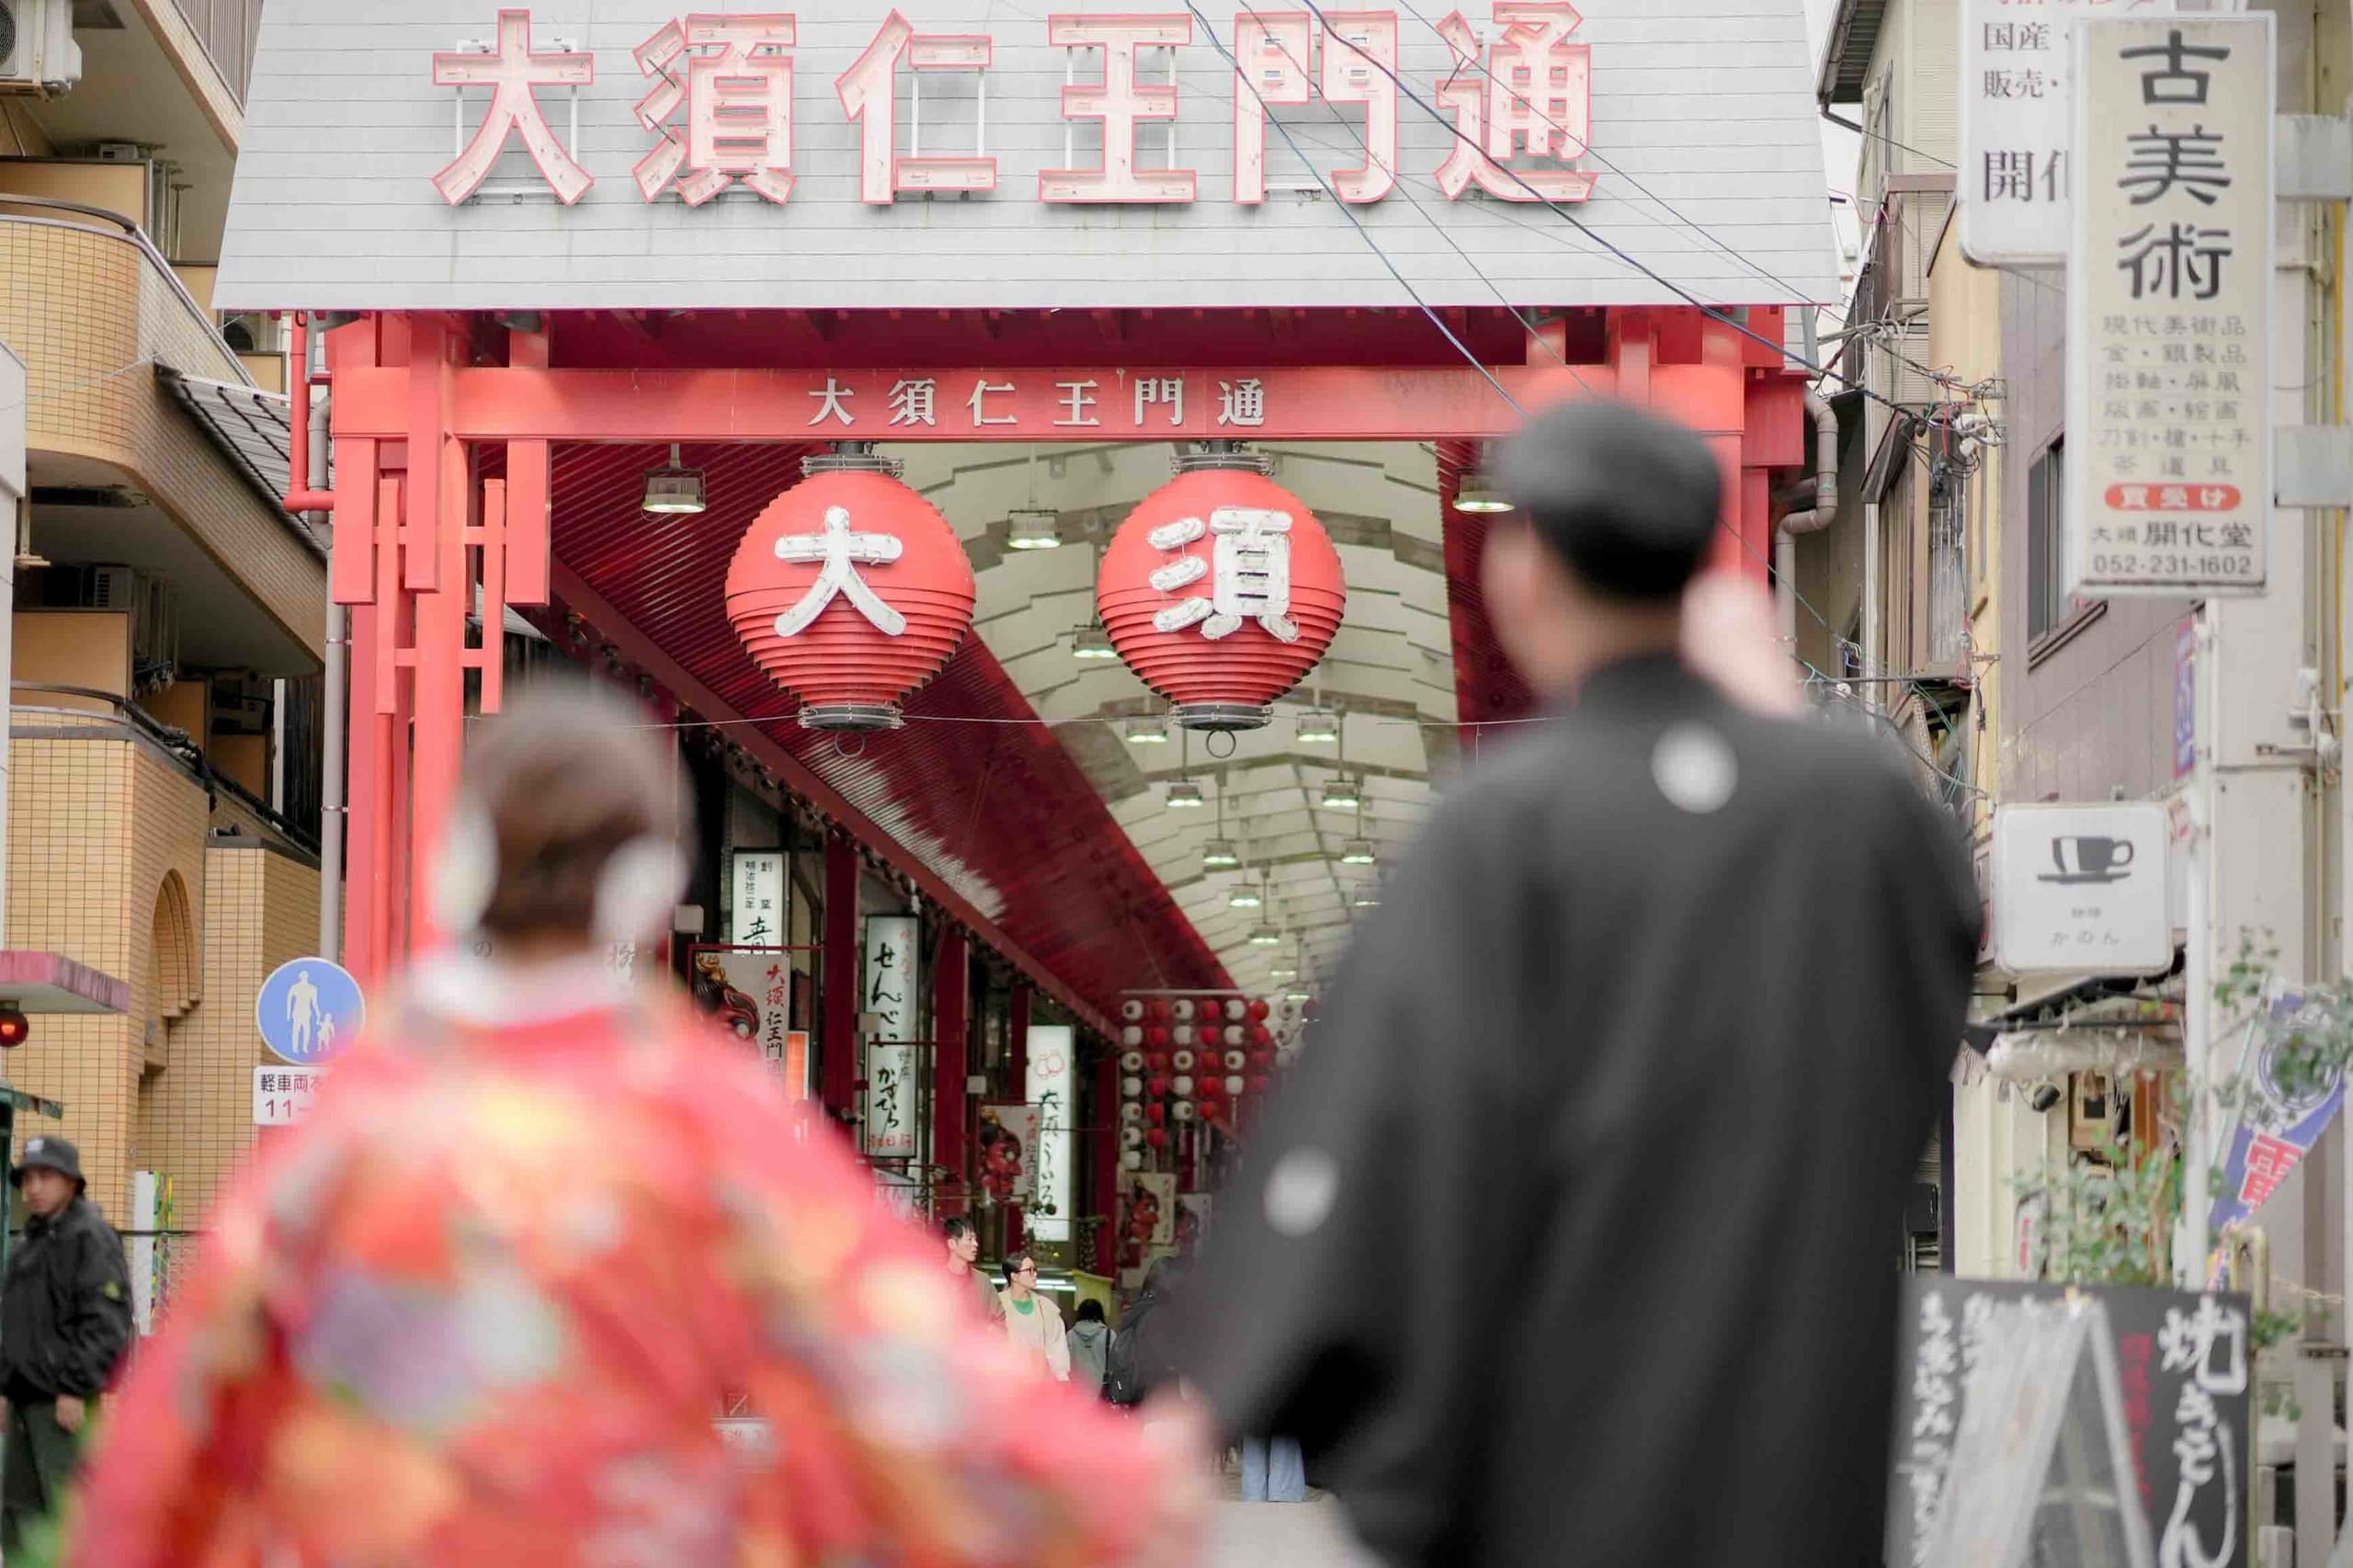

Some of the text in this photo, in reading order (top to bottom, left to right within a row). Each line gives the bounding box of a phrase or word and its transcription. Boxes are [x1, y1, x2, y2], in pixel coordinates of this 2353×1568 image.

[430, 2, 1599, 206] 大須仁王門通
[2118, 29, 2233, 300] 古美術
[808, 378, 1265, 427] 大須仁王門通
[774, 506, 906, 638] 大
[1147, 506, 1299, 642] 須
[2143, 521, 2253, 549] 開化堂
